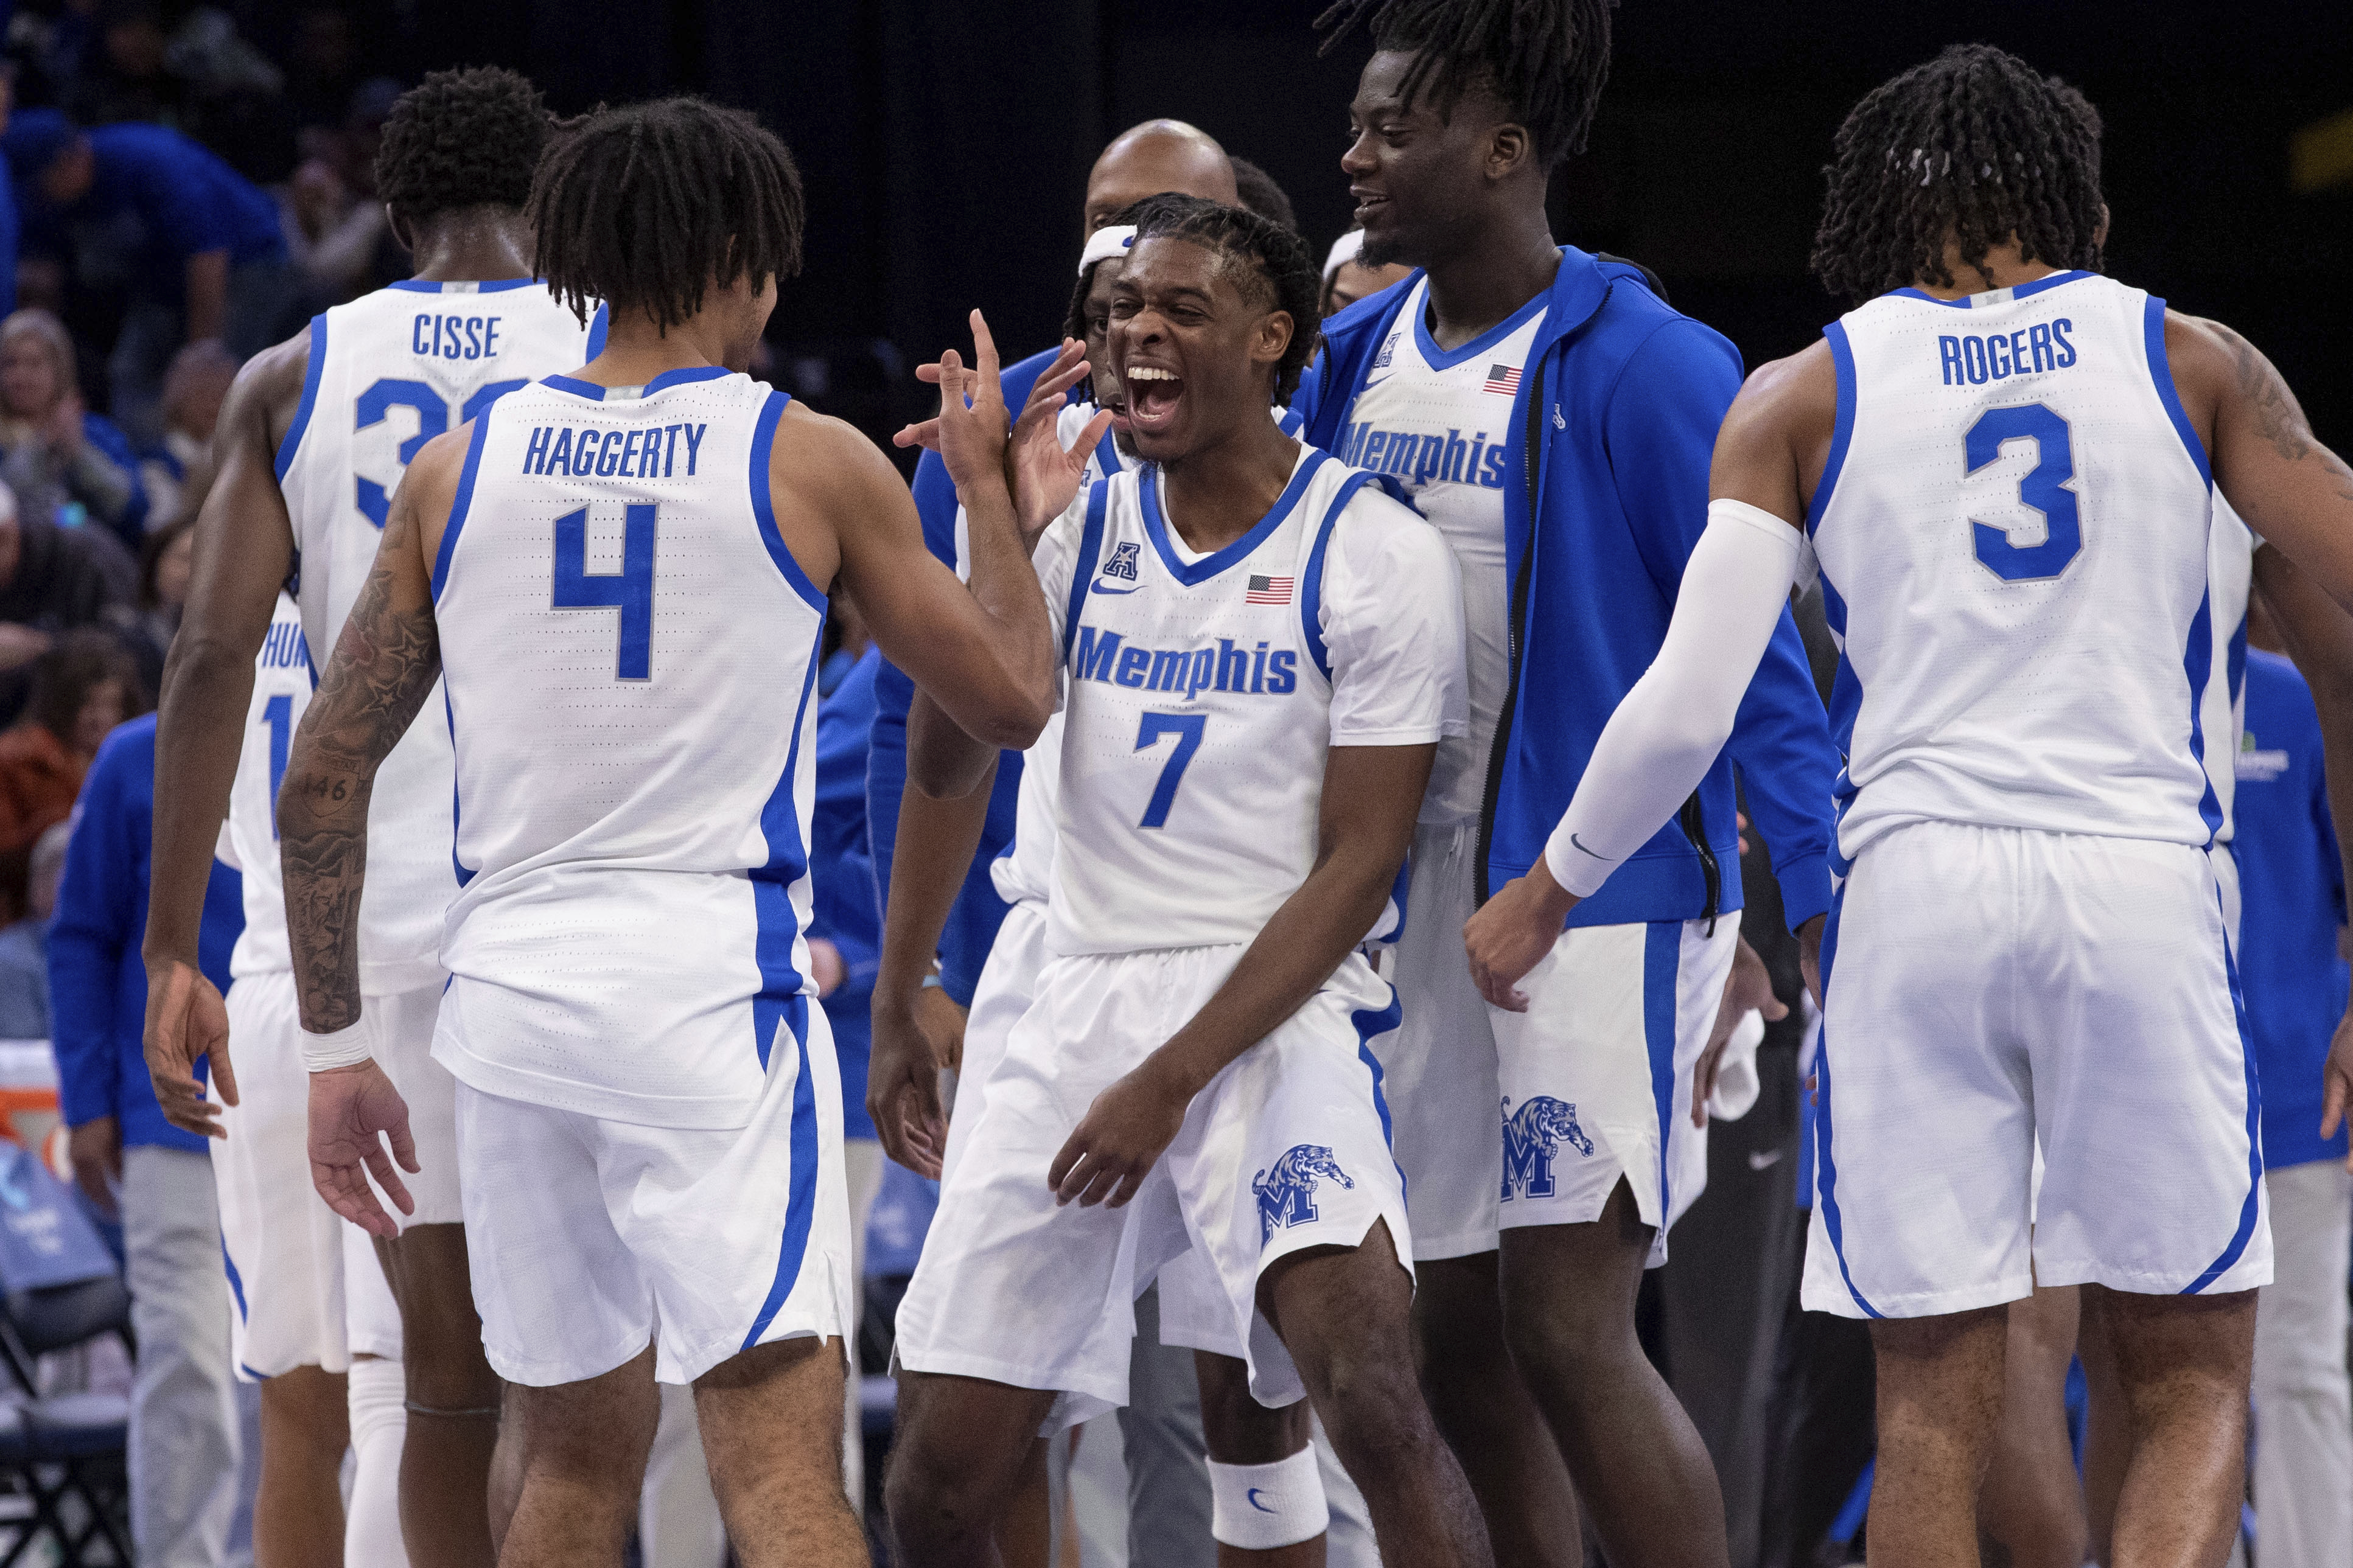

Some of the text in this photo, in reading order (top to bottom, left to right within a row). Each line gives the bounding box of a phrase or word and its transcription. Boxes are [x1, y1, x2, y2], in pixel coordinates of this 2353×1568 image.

[412, 313, 502, 360] CISSE
[1938, 318, 2077, 386] ROGERS
[354, 377, 532, 531] 3
[522, 423, 708, 478] HAGGERTY
[1340, 421, 1506, 490] Memphis
[1961, 401, 2085, 584] 3
[550, 501, 661, 683] 4
[1102, 542, 1141, 582] A
[1074, 625, 1298, 702] Memphis
[1133, 711, 1209, 830] 7
